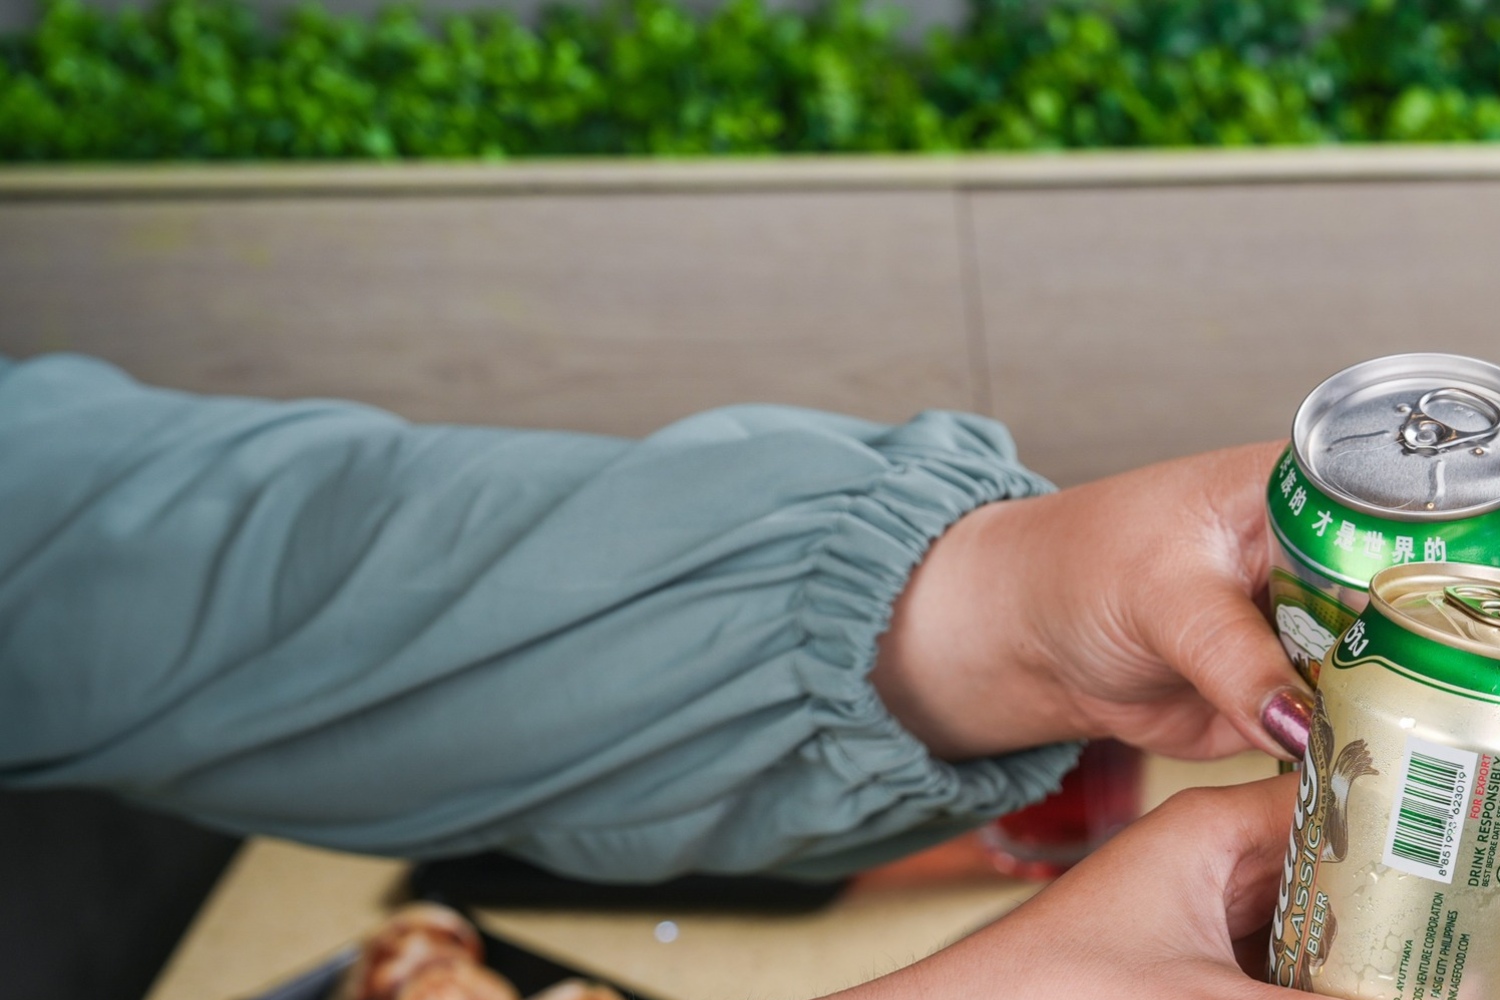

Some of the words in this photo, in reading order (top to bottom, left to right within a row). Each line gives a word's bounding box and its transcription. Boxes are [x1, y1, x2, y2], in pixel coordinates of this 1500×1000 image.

[1312, 510, 1447, 563] 才是世界的
[1475, 754, 1492, 796] EXPORT
[1470, 799, 1482, 819] FOR
[1468, 847, 1487, 887] DRINK
[1485, 841, 1498, 870] BEFORE
[1481, 870, 1491, 887] BEST
[1277, 821, 1322, 988] CLASSIC
[1306, 891, 1329, 957] BEER
[1424, 892, 1445, 949] CORPORATION
[1440, 910, 1459, 956] PHILIPPINES
[1396, 939, 1414, 992] AYUTTHAYA
[1416, 949, 1433, 985] VENTURE
[1436, 957, 1448, 977] CITY
